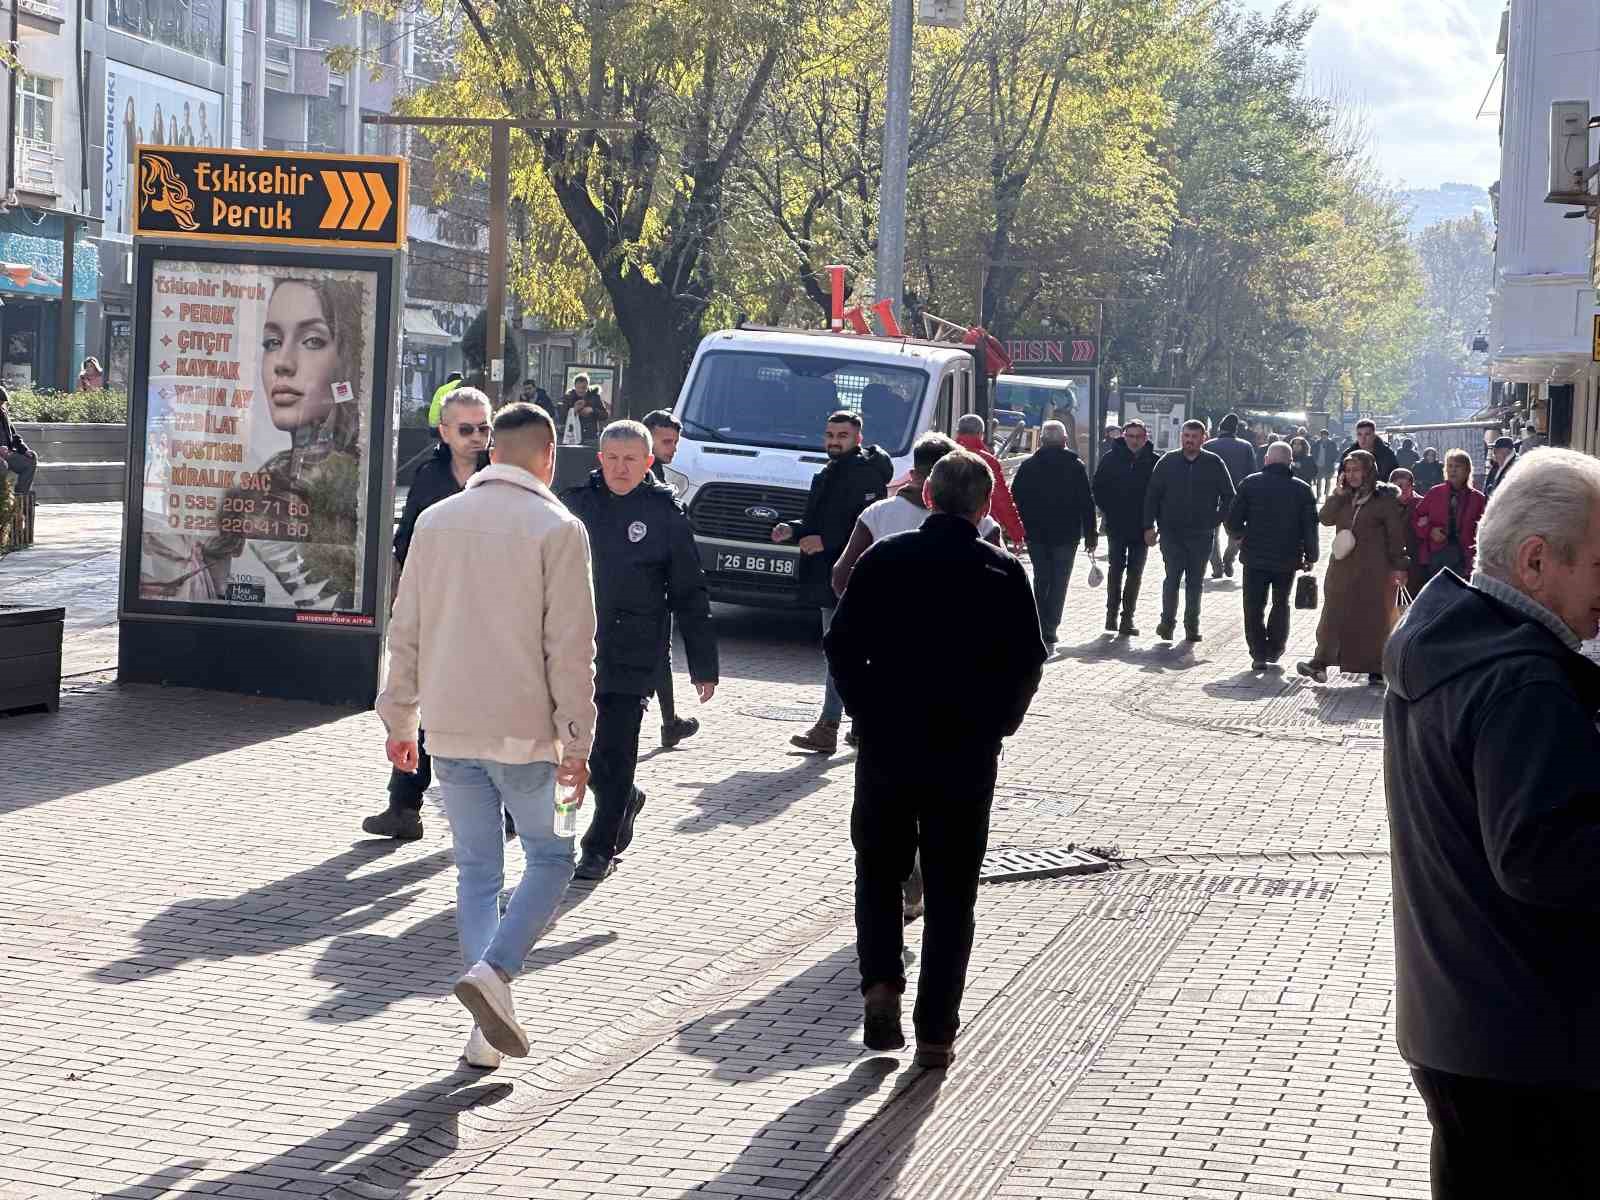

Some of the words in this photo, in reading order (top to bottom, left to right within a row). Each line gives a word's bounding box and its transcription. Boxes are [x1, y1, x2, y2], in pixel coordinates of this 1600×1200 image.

[193, 161, 313, 196] Eskisehir
[105, 179, 113, 211] LC
[212, 196, 293, 230] Peruk
[179, 302, 236, 325] PERUK
[1004, 339, 1065, 362] HSN
[175, 358, 240, 380] KAYNAK
[231, 388, 255, 409] AY
[239, 471, 272, 496] SAÇ
[168, 493, 180, 509] 0
[223, 497, 256, 514] 203
[262, 500, 281, 514] 71
[288, 502, 310, 517] 60
[168, 514, 180, 529] 0
[221, 518, 255, 533] 220
[287, 523, 309, 537] 60
[724, 554, 741, 569] 26
[745, 556, 766, 571] BG
[769, 559, 794, 574] 158
